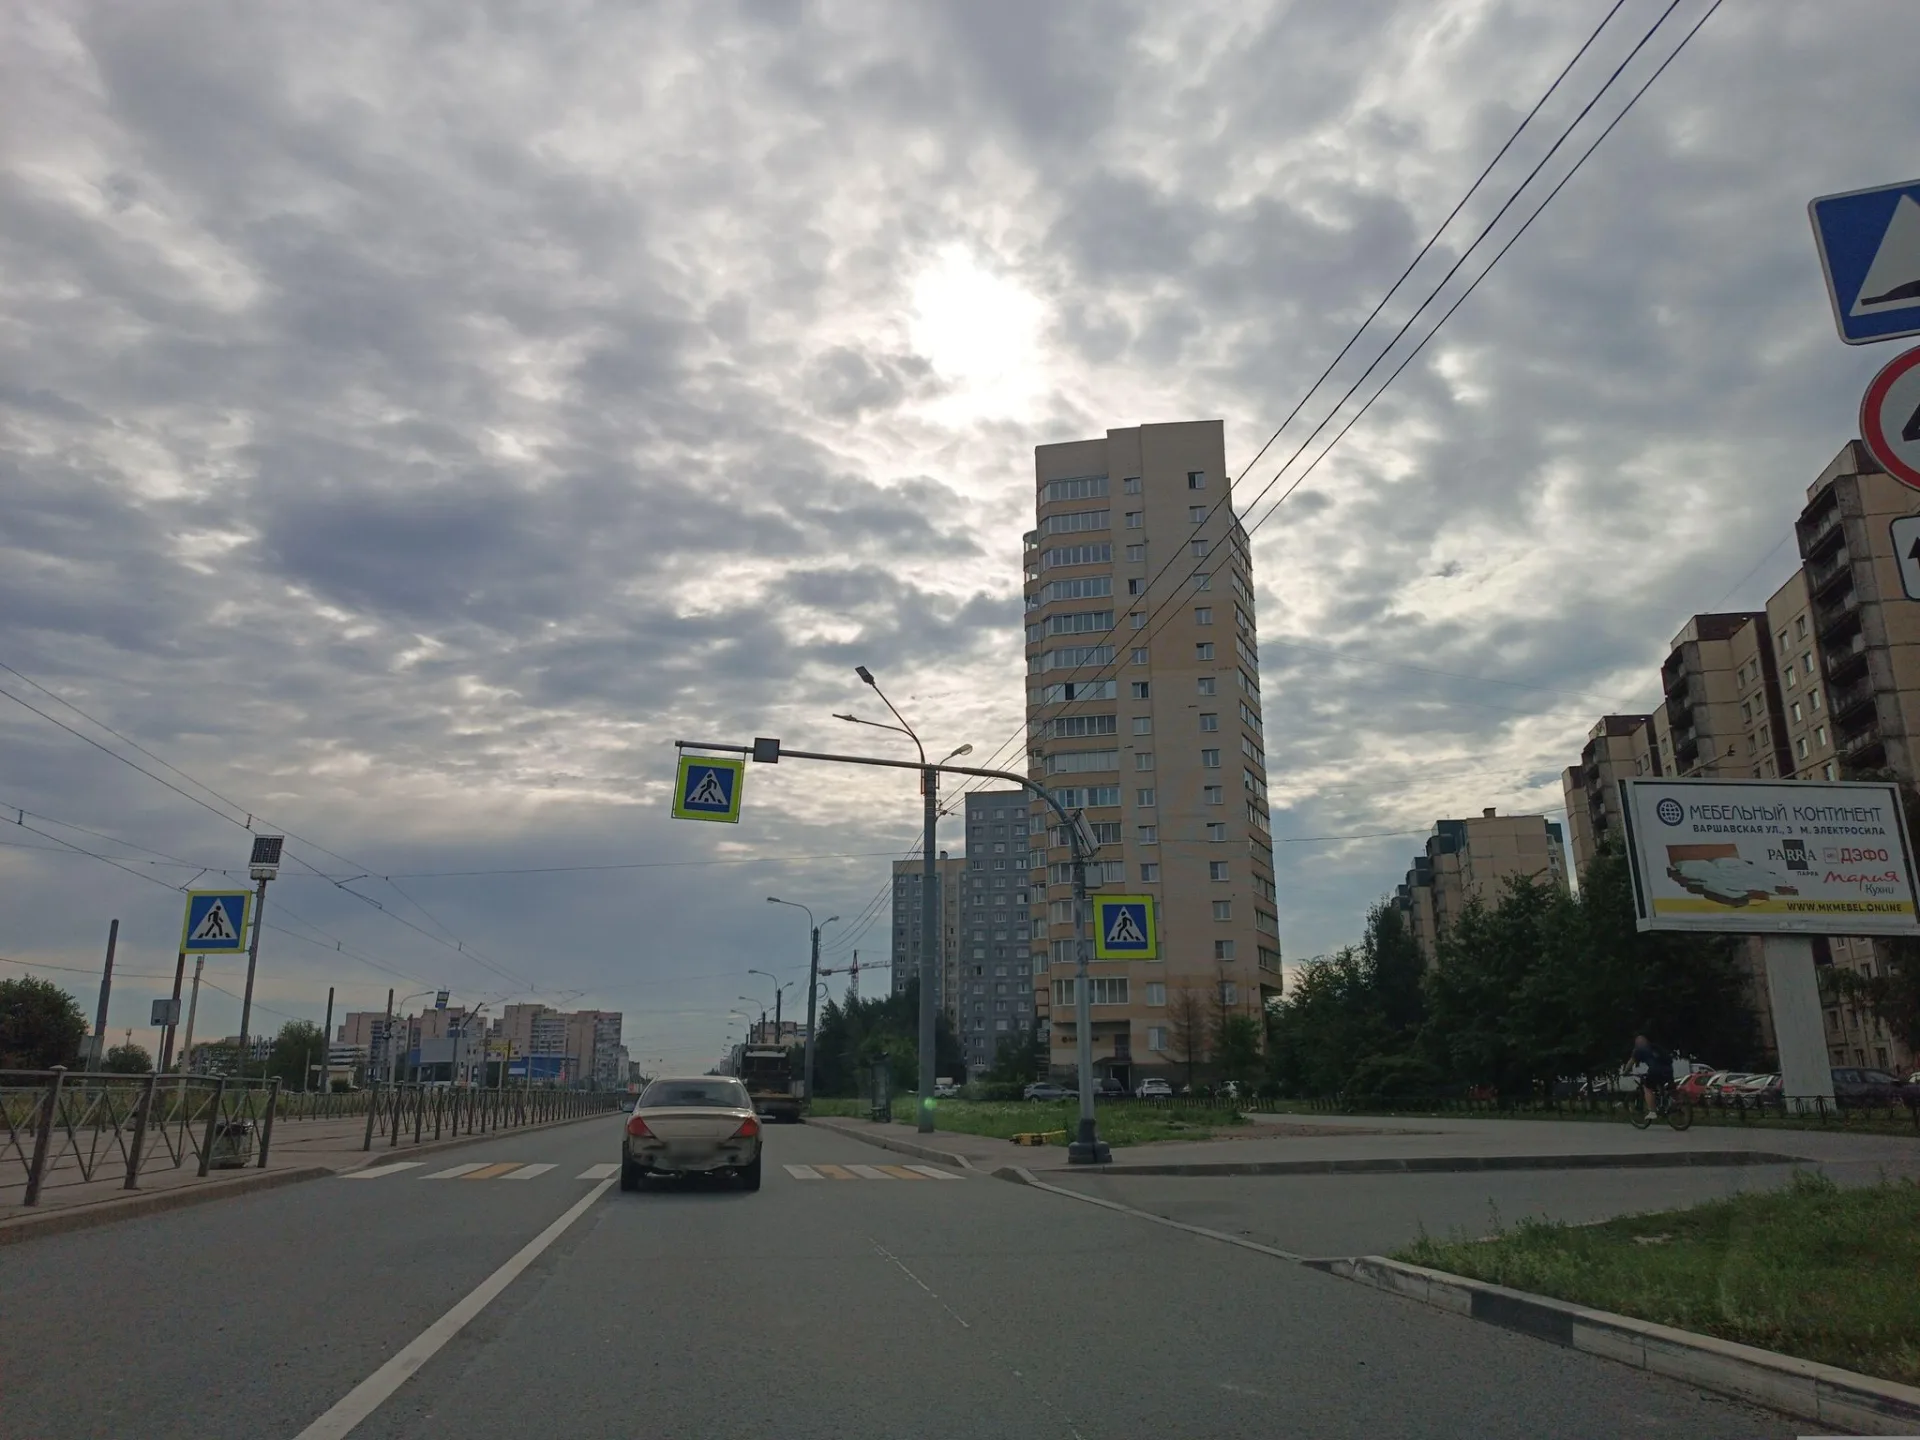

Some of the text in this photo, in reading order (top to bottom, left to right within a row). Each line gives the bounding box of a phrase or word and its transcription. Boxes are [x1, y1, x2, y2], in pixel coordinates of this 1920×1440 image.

[1689, 803, 1882, 822] МЕБЕЛЬНЫЙ КОНТИНЕНТ
[1693, 824, 1763, 833] ВАРШАВСКАЯ
[1800, 826, 1811, 834] М.
[1814, 826, 1886, 835] ЭЛЕКТРОСИЛА
[1767, 848, 1818, 861] PARRA
[1787, 903, 1902, 912] WWW.MKMEBEL.ONLINE
